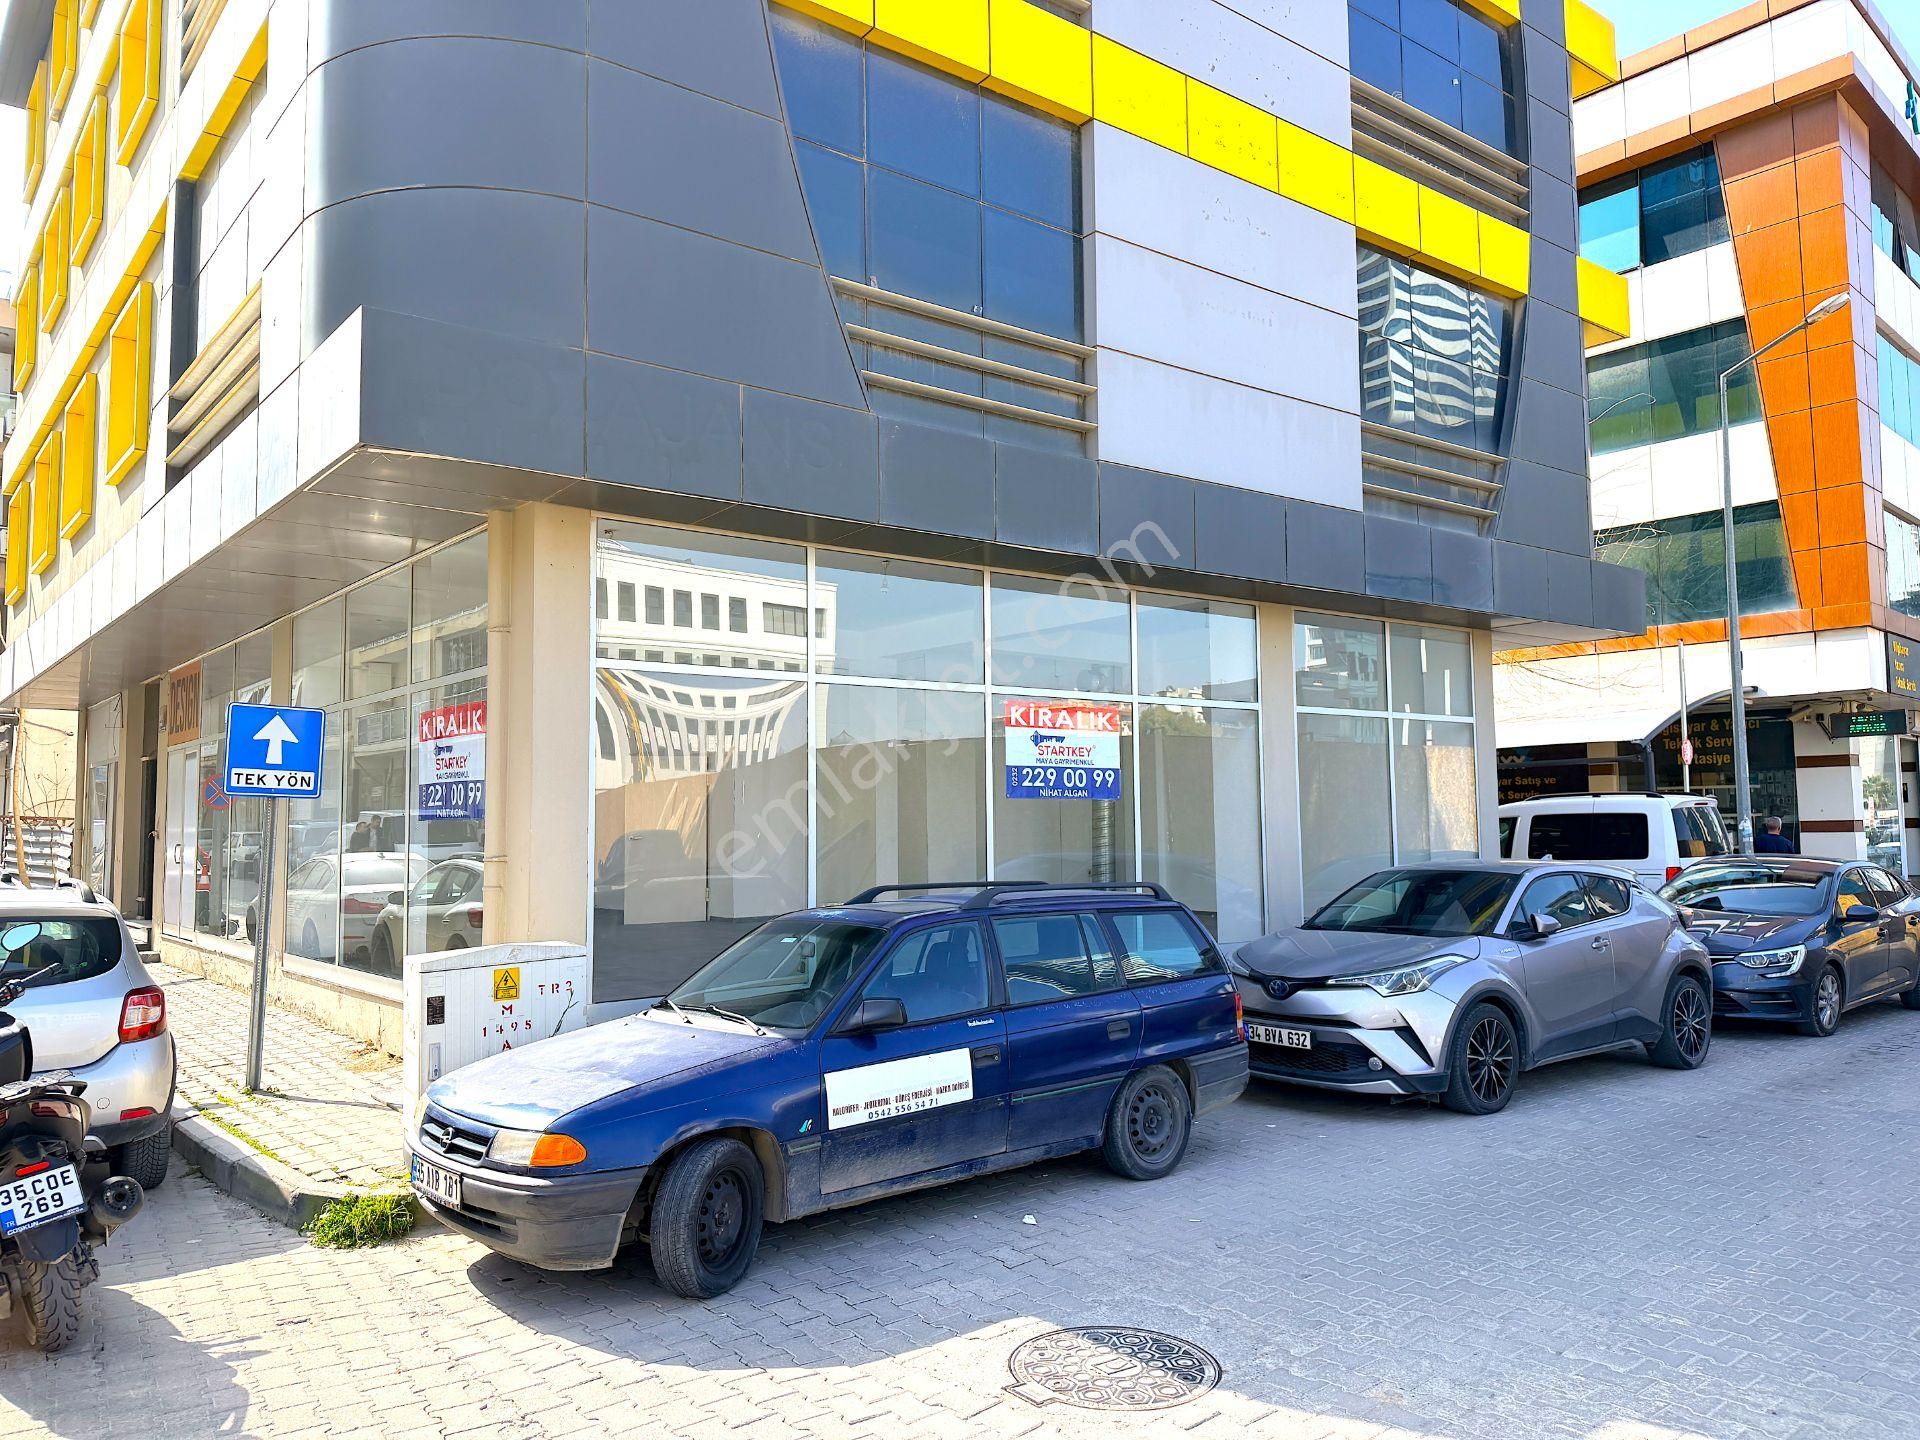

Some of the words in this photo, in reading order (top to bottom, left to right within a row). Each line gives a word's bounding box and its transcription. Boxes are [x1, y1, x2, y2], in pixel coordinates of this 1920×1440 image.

[170, 672, 200, 734] DESIGN
[422, 709, 483, 739] KİRALIK
[1010, 703, 1113, 731] KİRALIK
[1710, 719, 1720, 731] &
[1037, 745, 1092, 758] STARTKEY
[1663, 737, 1702, 749] Tekik
[1706, 736, 1734, 748] Serv
[234, 772, 267, 786] TEK
[274, 772, 311, 788] YÖN
[1022, 768, 1057, 787] 229
[1063, 769, 1087, 788] 00
[1093, 769, 1115, 788] 99
[1515, 776, 1541, 787] Satış
[1544, 777, 1557, 785] ve
[451, 783, 464, 806] 00
[468, 783, 482, 805] 99
[1040, 787, 1062, 797] NİHAT
[1064, 789, 1088, 797] ALGAN
[501, 1004, 513, 1015] M
[502, 1039, 512, 1051] A
[1249, 1026, 1261, 1041] 34
[1264, 1028, 1284, 1044] BVA
[1287, 1031, 1308, 1048] 632
[868, 1108, 892, 1119] 0542
[895, 1103, 912, 1113] 556
[915, 1100, 926, 1109] 54
[929, 1097, 939, 1107] 71
[0, 1184, 28, 1206] 35
[31, 1169, 74, 1196] COE
[21, 1192, 65, 1219] 269
[5, 1220, 16, 1228] TR
